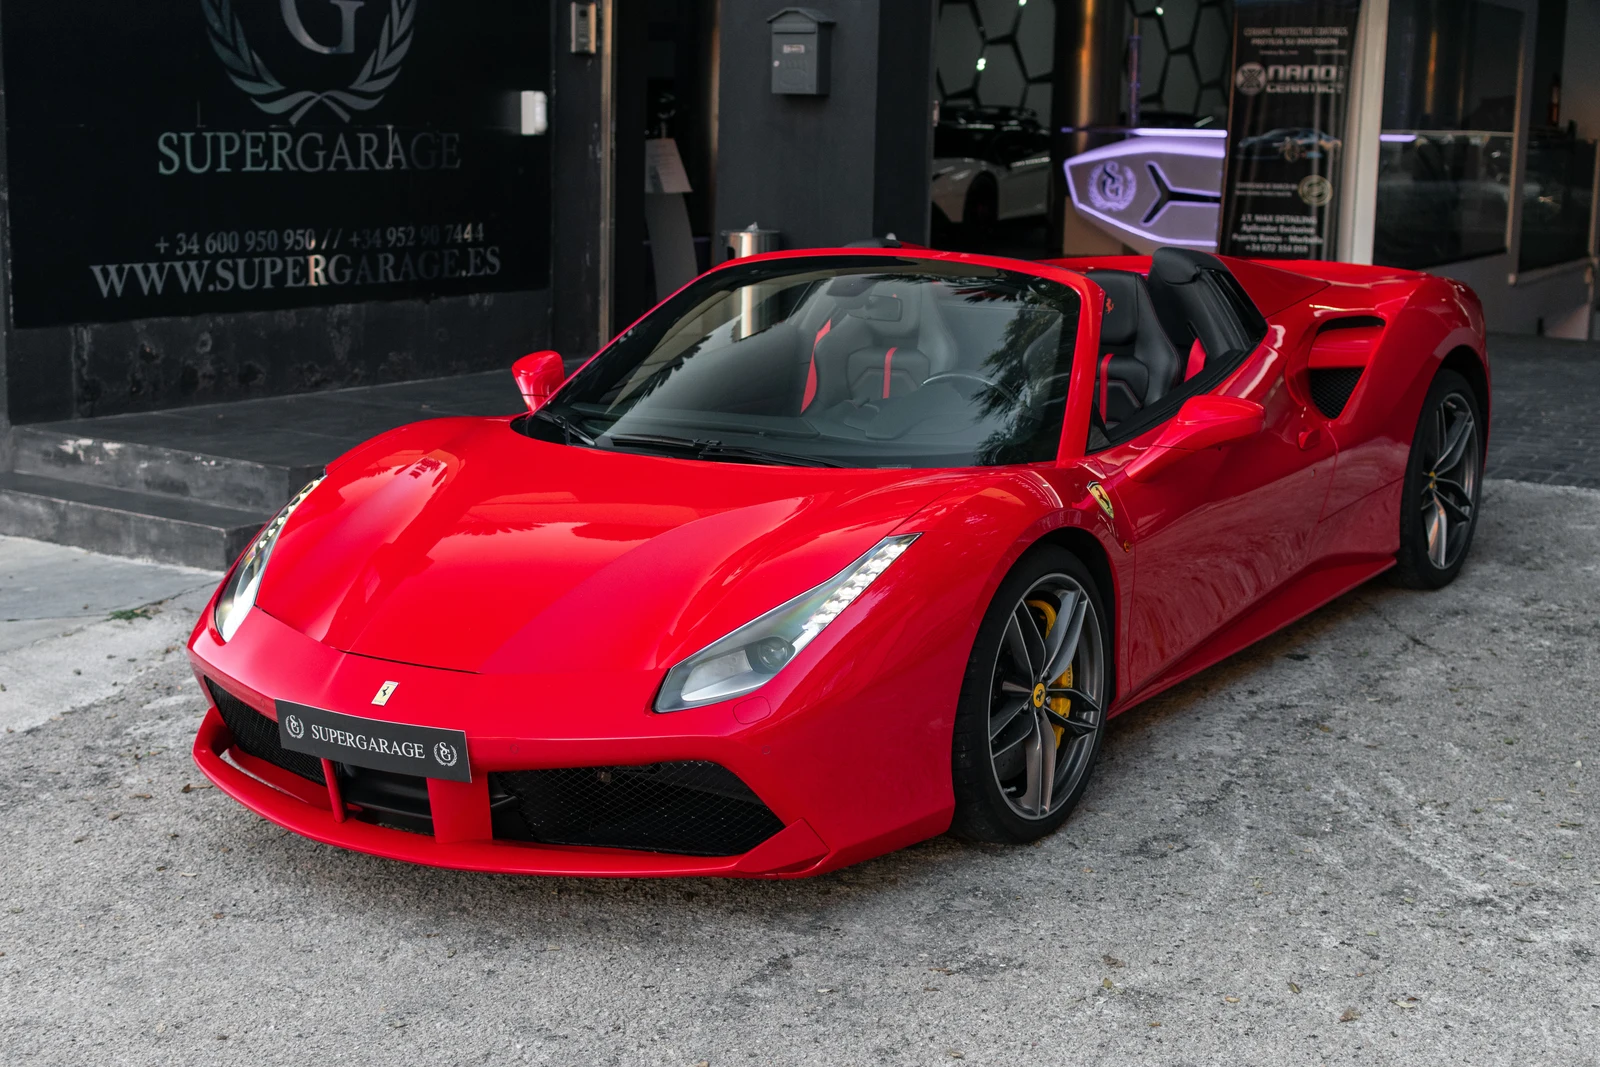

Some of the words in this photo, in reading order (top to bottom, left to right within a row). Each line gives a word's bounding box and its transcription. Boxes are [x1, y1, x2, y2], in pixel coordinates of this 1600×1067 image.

[1267, 64, 1338, 81] NANO
[157, 131, 461, 175] SUPERGARAGE
[1274, 215, 1317, 225] DETAILING
[176, 233, 200, 256] 34
[205, 231, 240, 255] 600
[245, 229, 279, 252] 950
[284, 228, 316, 251] 950
[386, 225, 416, 248] 952
[420, 224, 441, 246] 90
[445, 222, 485, 244] 7444
[89, 246, 501, 298] WWW.SUPERGARAGE.ES
[311, 724, 426, 759] SUPERGARAGE
